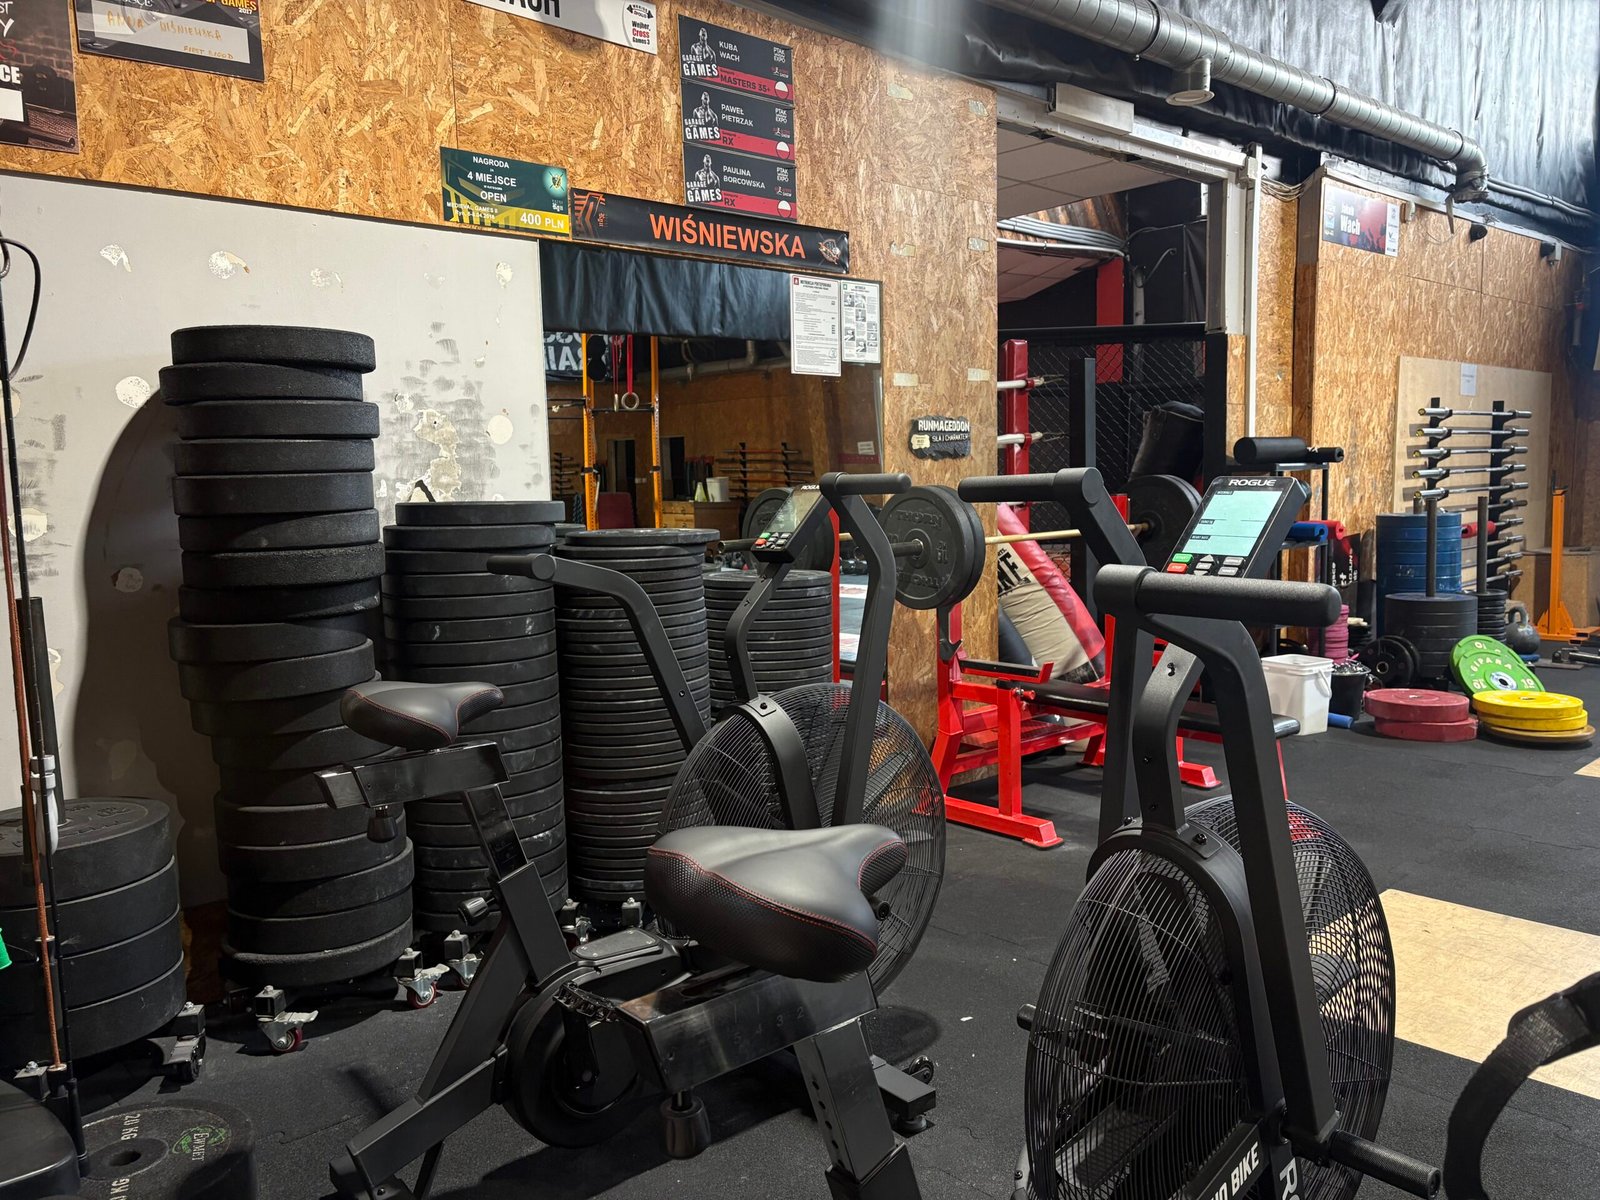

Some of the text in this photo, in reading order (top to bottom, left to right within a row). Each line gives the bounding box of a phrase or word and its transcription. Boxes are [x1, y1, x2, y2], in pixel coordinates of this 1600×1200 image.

[221, 0, 257, 11] GAMES
[632, 28, 650, 38] Cross
[718, 40, 738, 52] KUBA
[719, 51, 740, 62] WACH
[682, 63, 719, 77] GAMES
[719, 75, 756, 90] MASTERS
[720, 103, 745, 115] PAWEŁ
[721, 113, 754, 127] PIETRZAK
[685, 126, 720, 140] GAMES
[722, 136, 734, 146] RX
[472, 156, 510, 169] NAGRODA
[722, 165, 751, 177] PAULINA
[467, 171, 517, 187] 4 MIEJSCE
[480, 190, 507, 203] OPEN
[687, 188, 722, 202] GAMES
[724, 198, 736, 207] RX
[520, 212, 564, 229] 400 PLN
[650, 213, 806, 259] WIŚNIEWSKA
[918, 420, 970, 432] RUNMAGEDDON
[1228, 479, 1277, 487] ROGUE
[1231, 1141, 1260, 1197] BIKE
